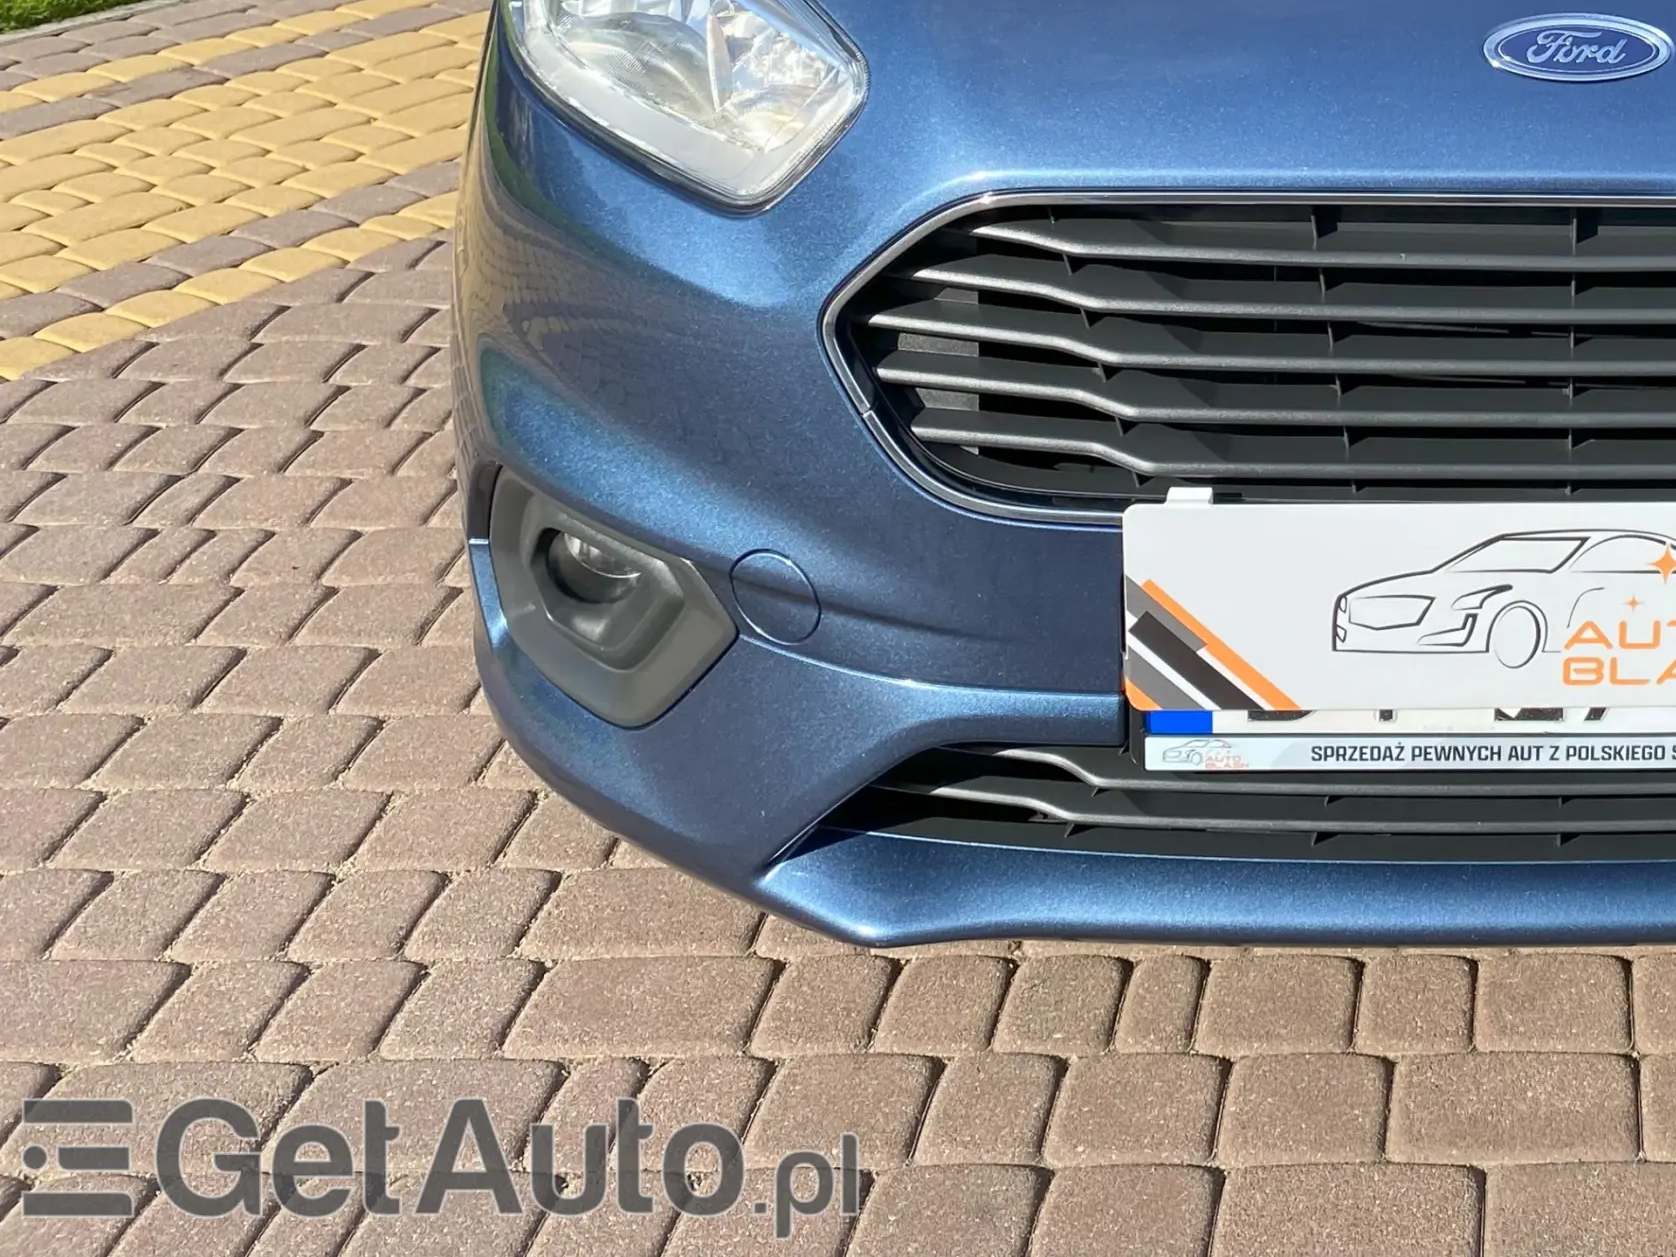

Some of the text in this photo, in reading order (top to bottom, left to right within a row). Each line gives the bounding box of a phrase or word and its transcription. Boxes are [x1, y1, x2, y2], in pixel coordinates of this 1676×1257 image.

[1526, 30, 1627, 64] Ford
[1311, 742, 1405, 762] SPRZEDAŻ
[1411, 745, 1502, 762] PEWNYCH
[1507, 745, 1544, 762] AUT
[1548, 745, 1560, 761] Z
[1565, 744, 1666, 761] POLSKIEGO
